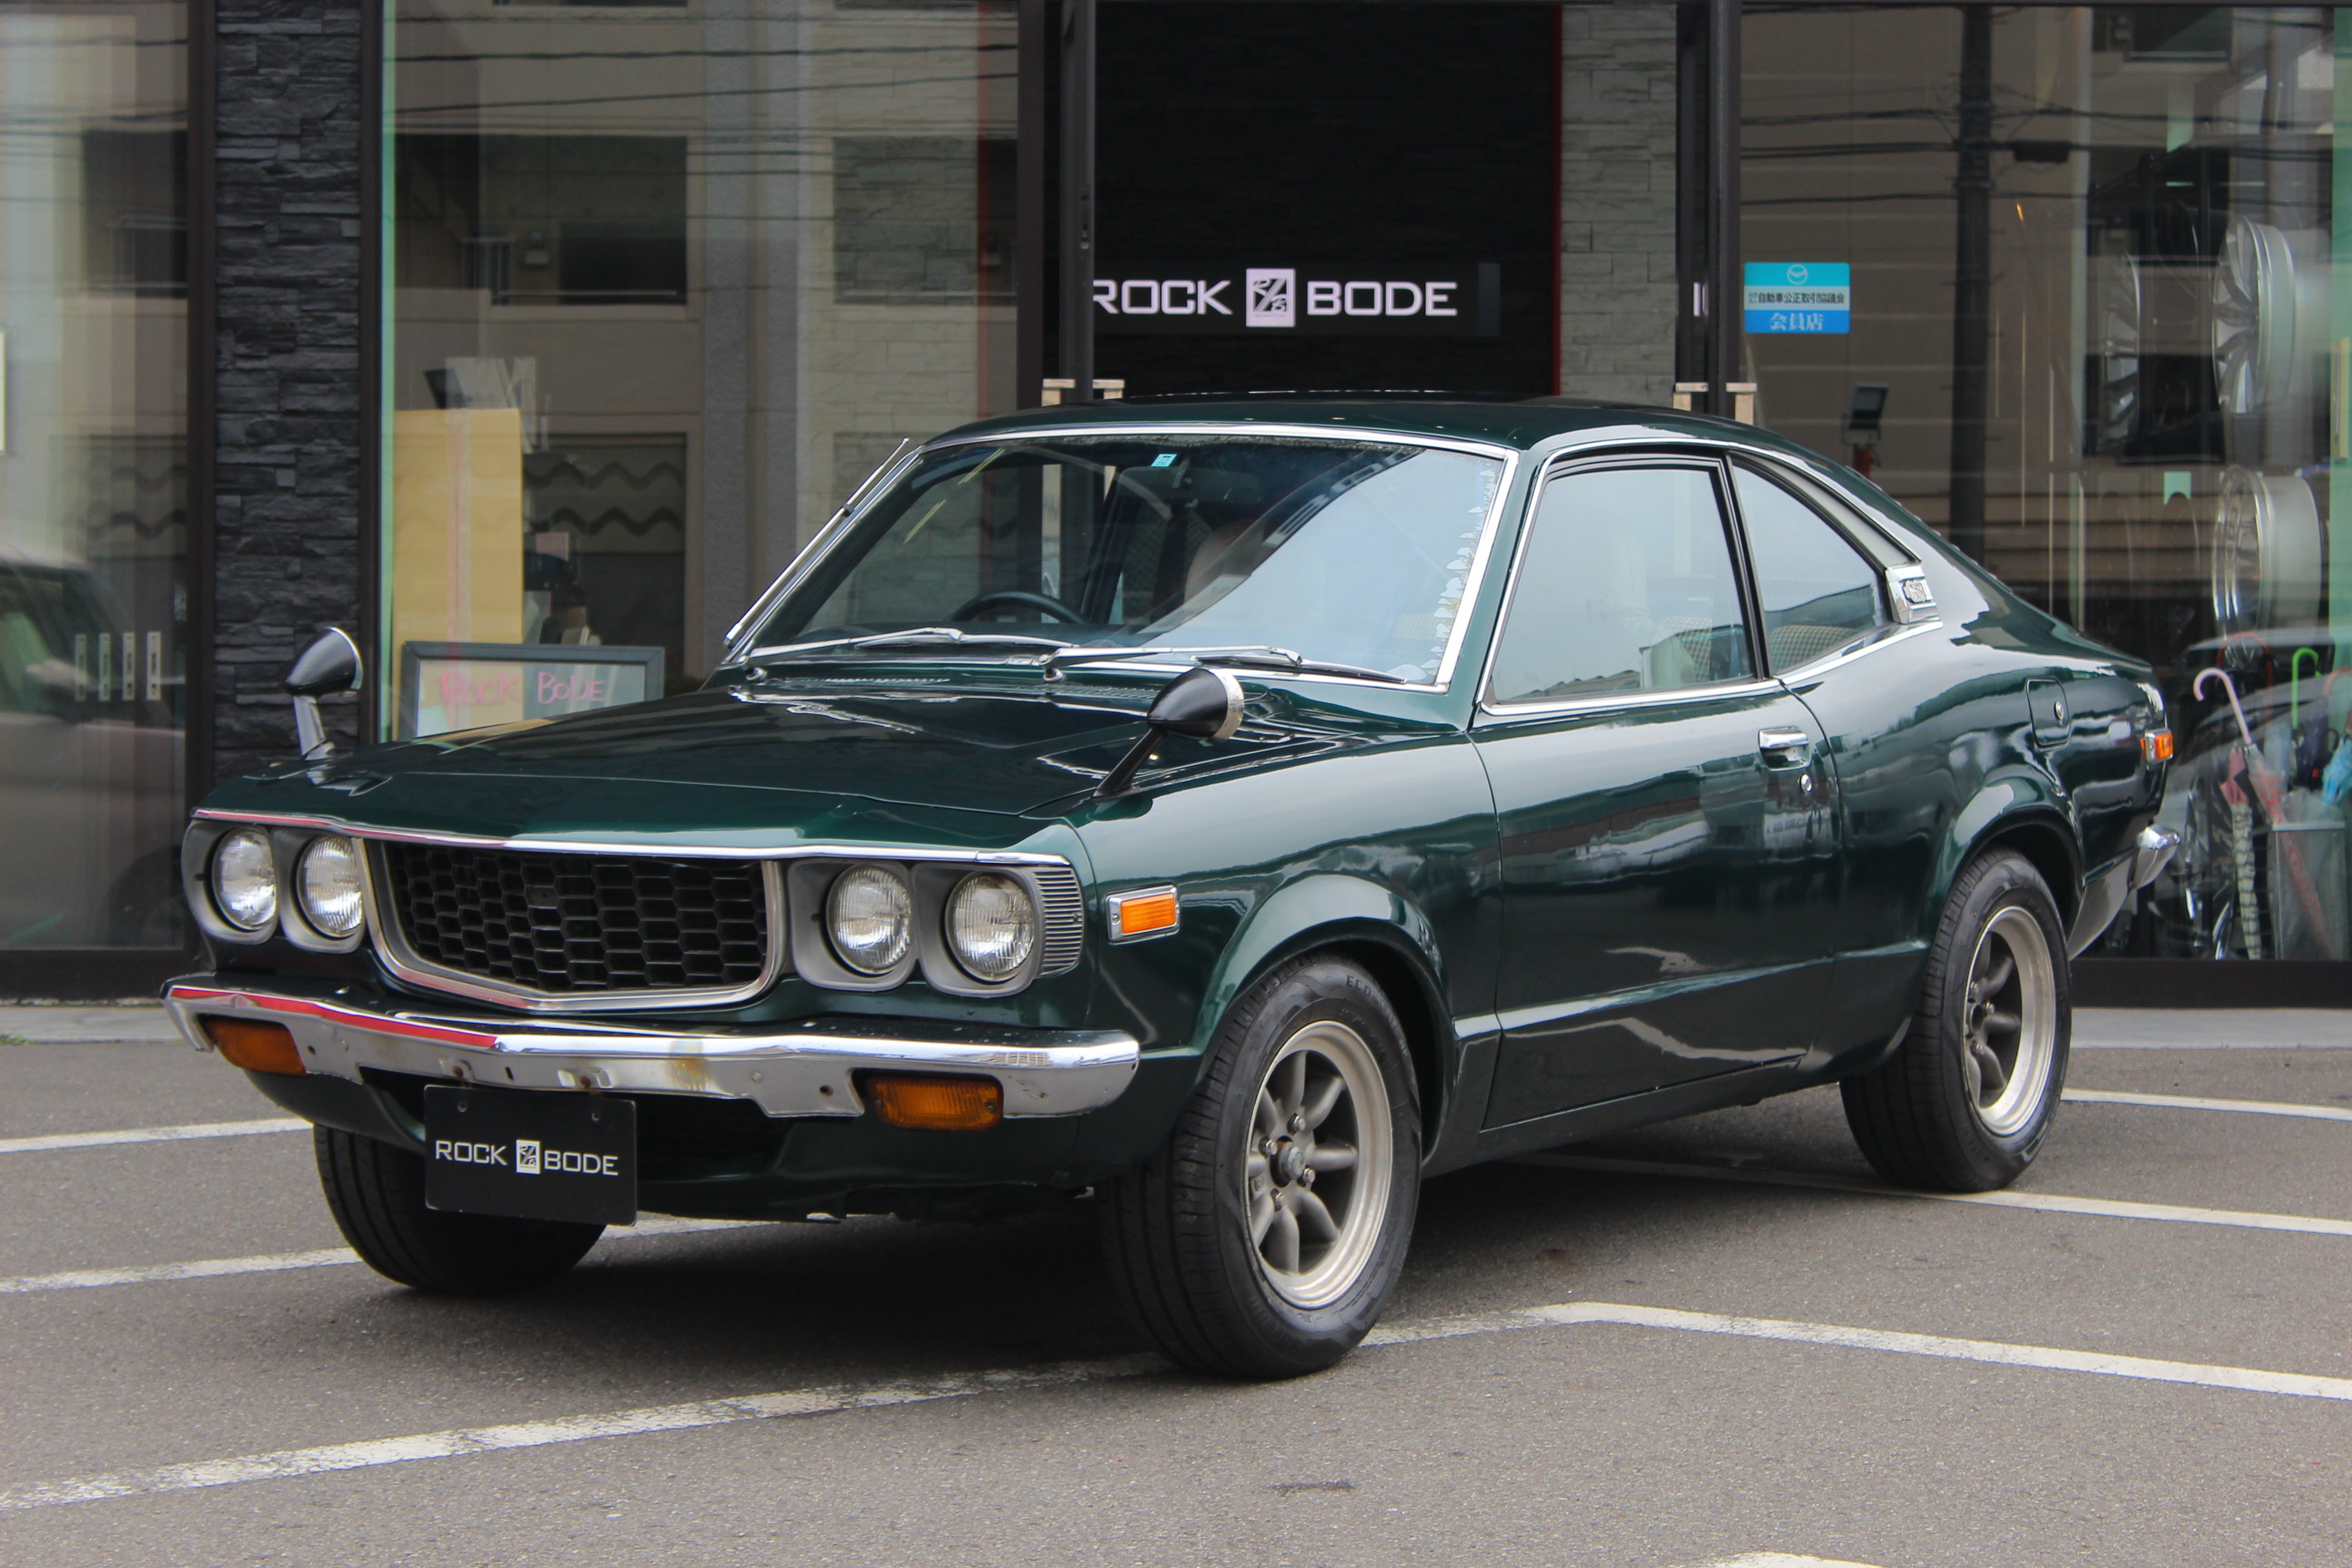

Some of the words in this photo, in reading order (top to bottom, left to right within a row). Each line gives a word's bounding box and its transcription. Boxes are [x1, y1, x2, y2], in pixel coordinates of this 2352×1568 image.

[1093, 279, 1232, 315] ROCK
[1308, 281, 1457, 316] BODE
[1770, 312, 1823, 330] 会員店
[436, 1140, 507, 1166] ROCK
[544, 1150, 619, 1176] BODE
